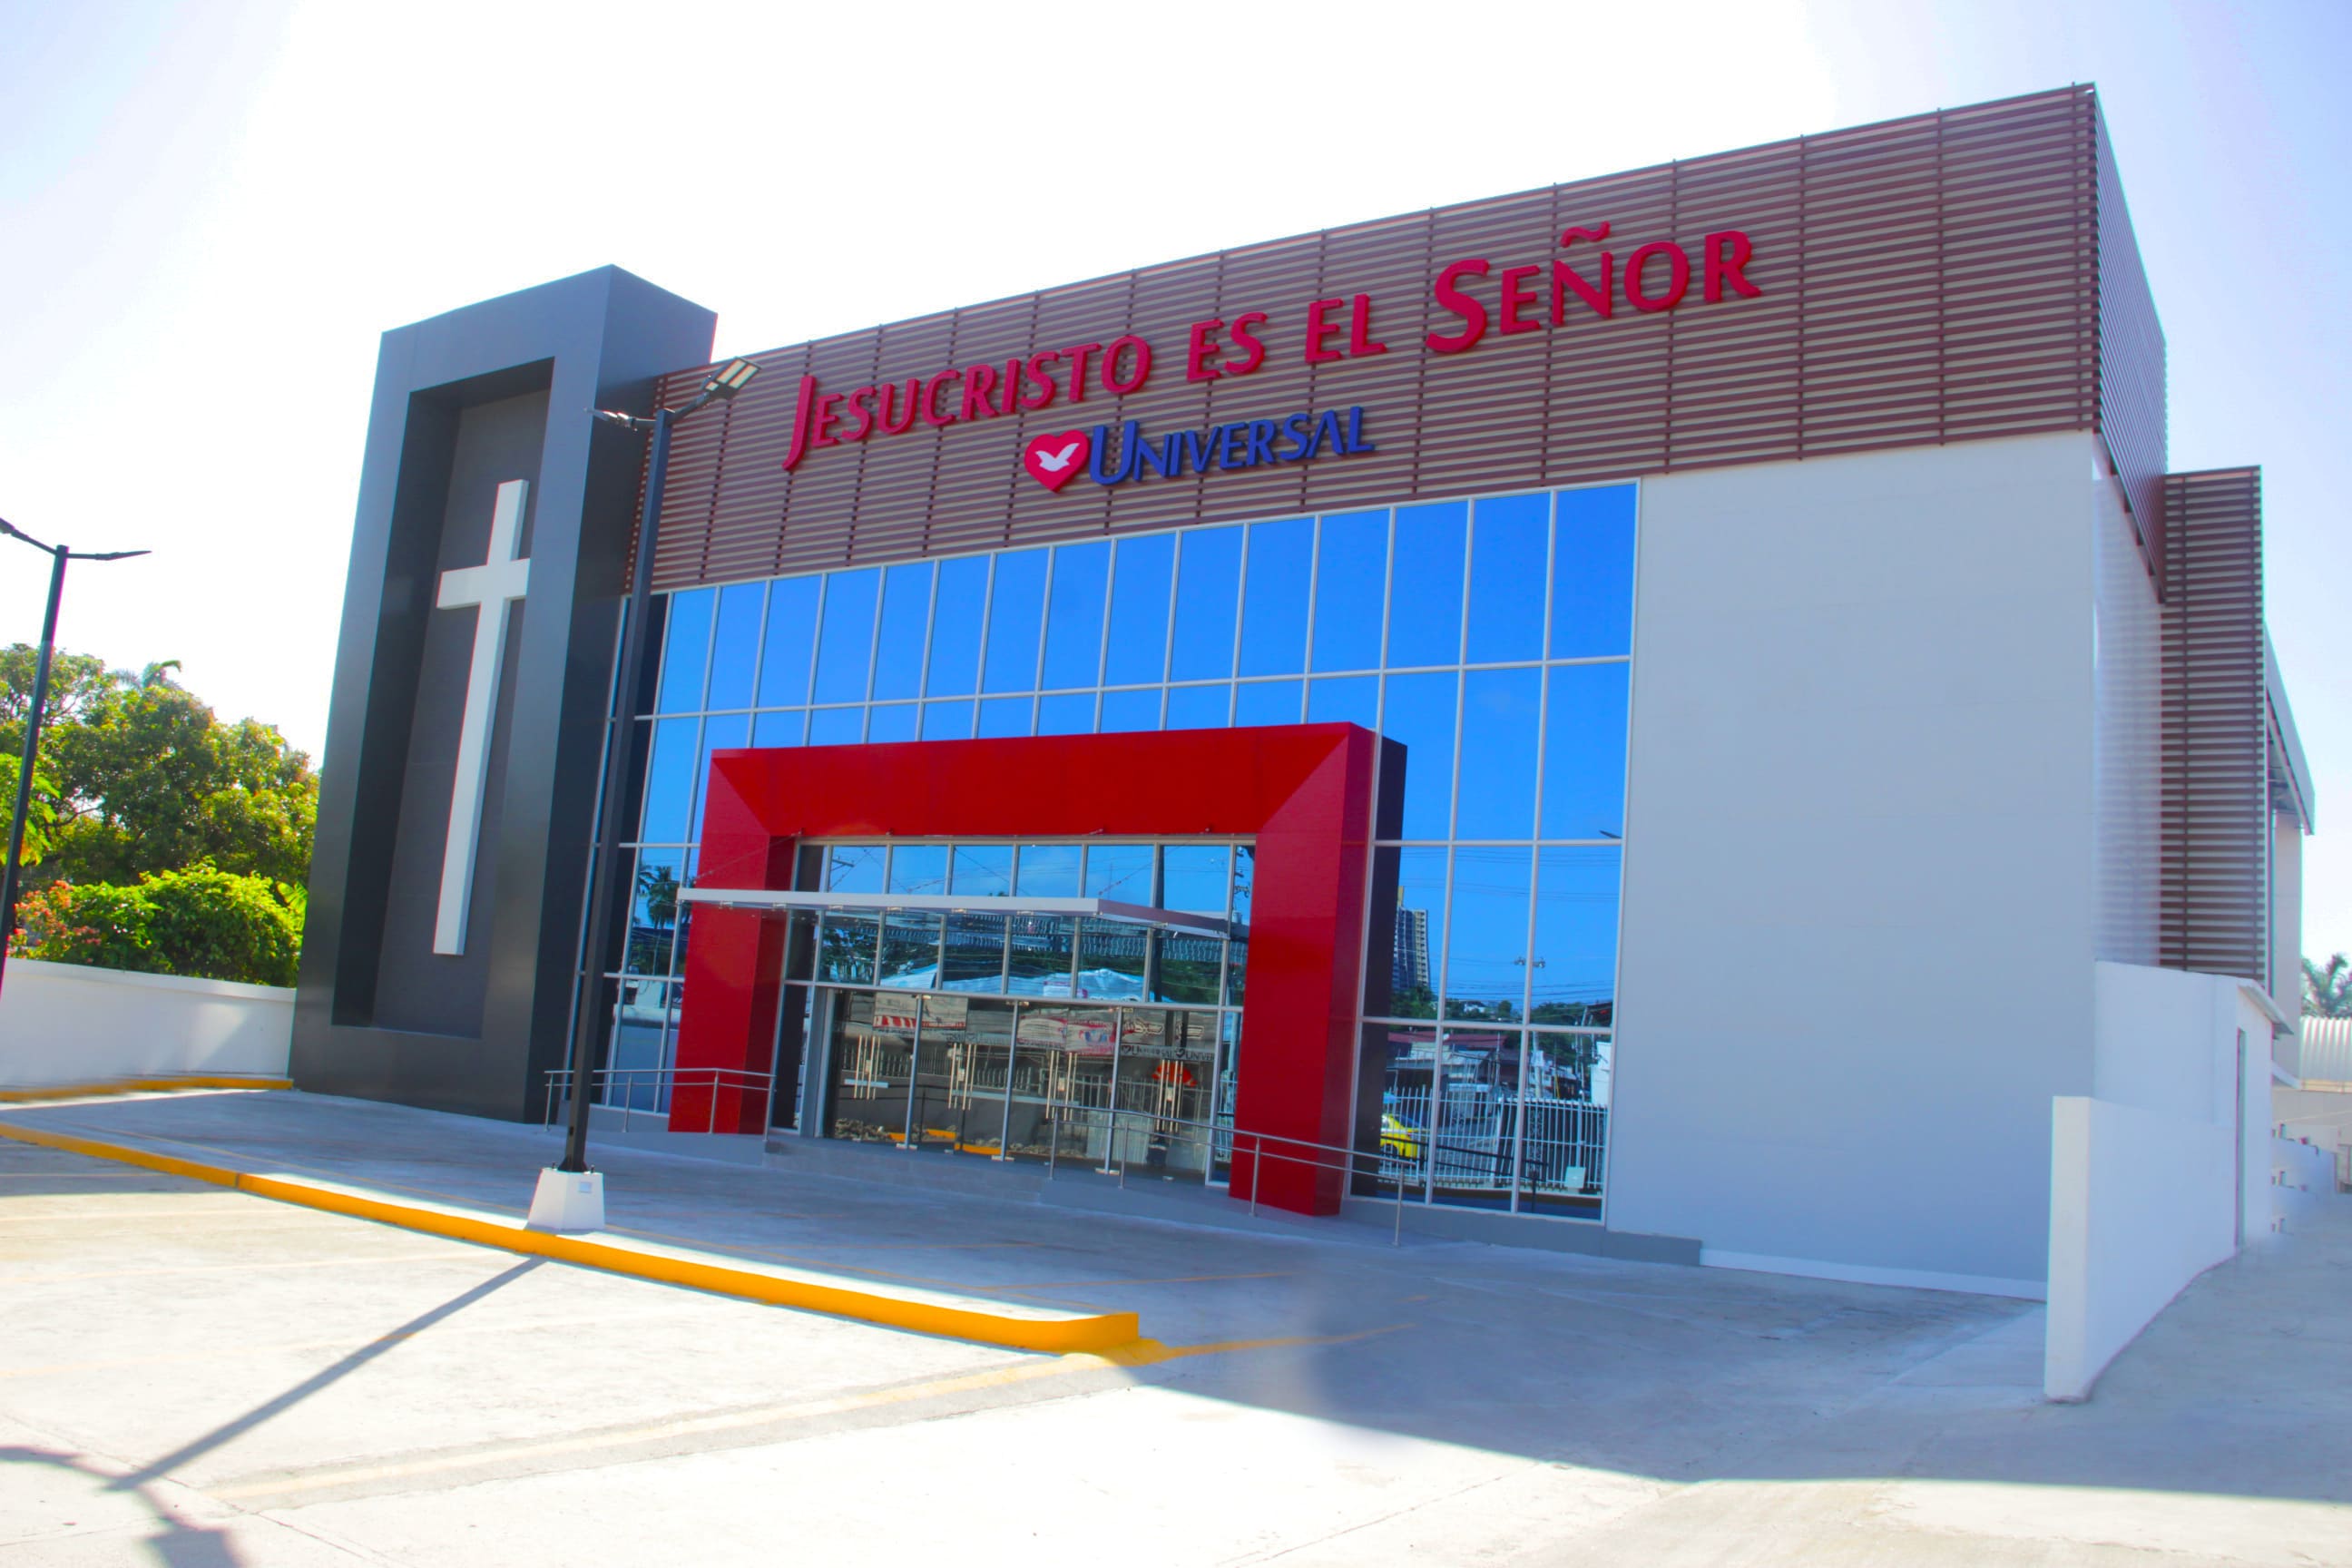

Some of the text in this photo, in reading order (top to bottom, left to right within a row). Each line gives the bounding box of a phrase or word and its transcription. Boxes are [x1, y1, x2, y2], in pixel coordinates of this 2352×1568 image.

[782, 220, 1761, 472] JESUCRISTO ES EL SEÑOR
[1090, 406, 1375, 485] UNIVERSAL
